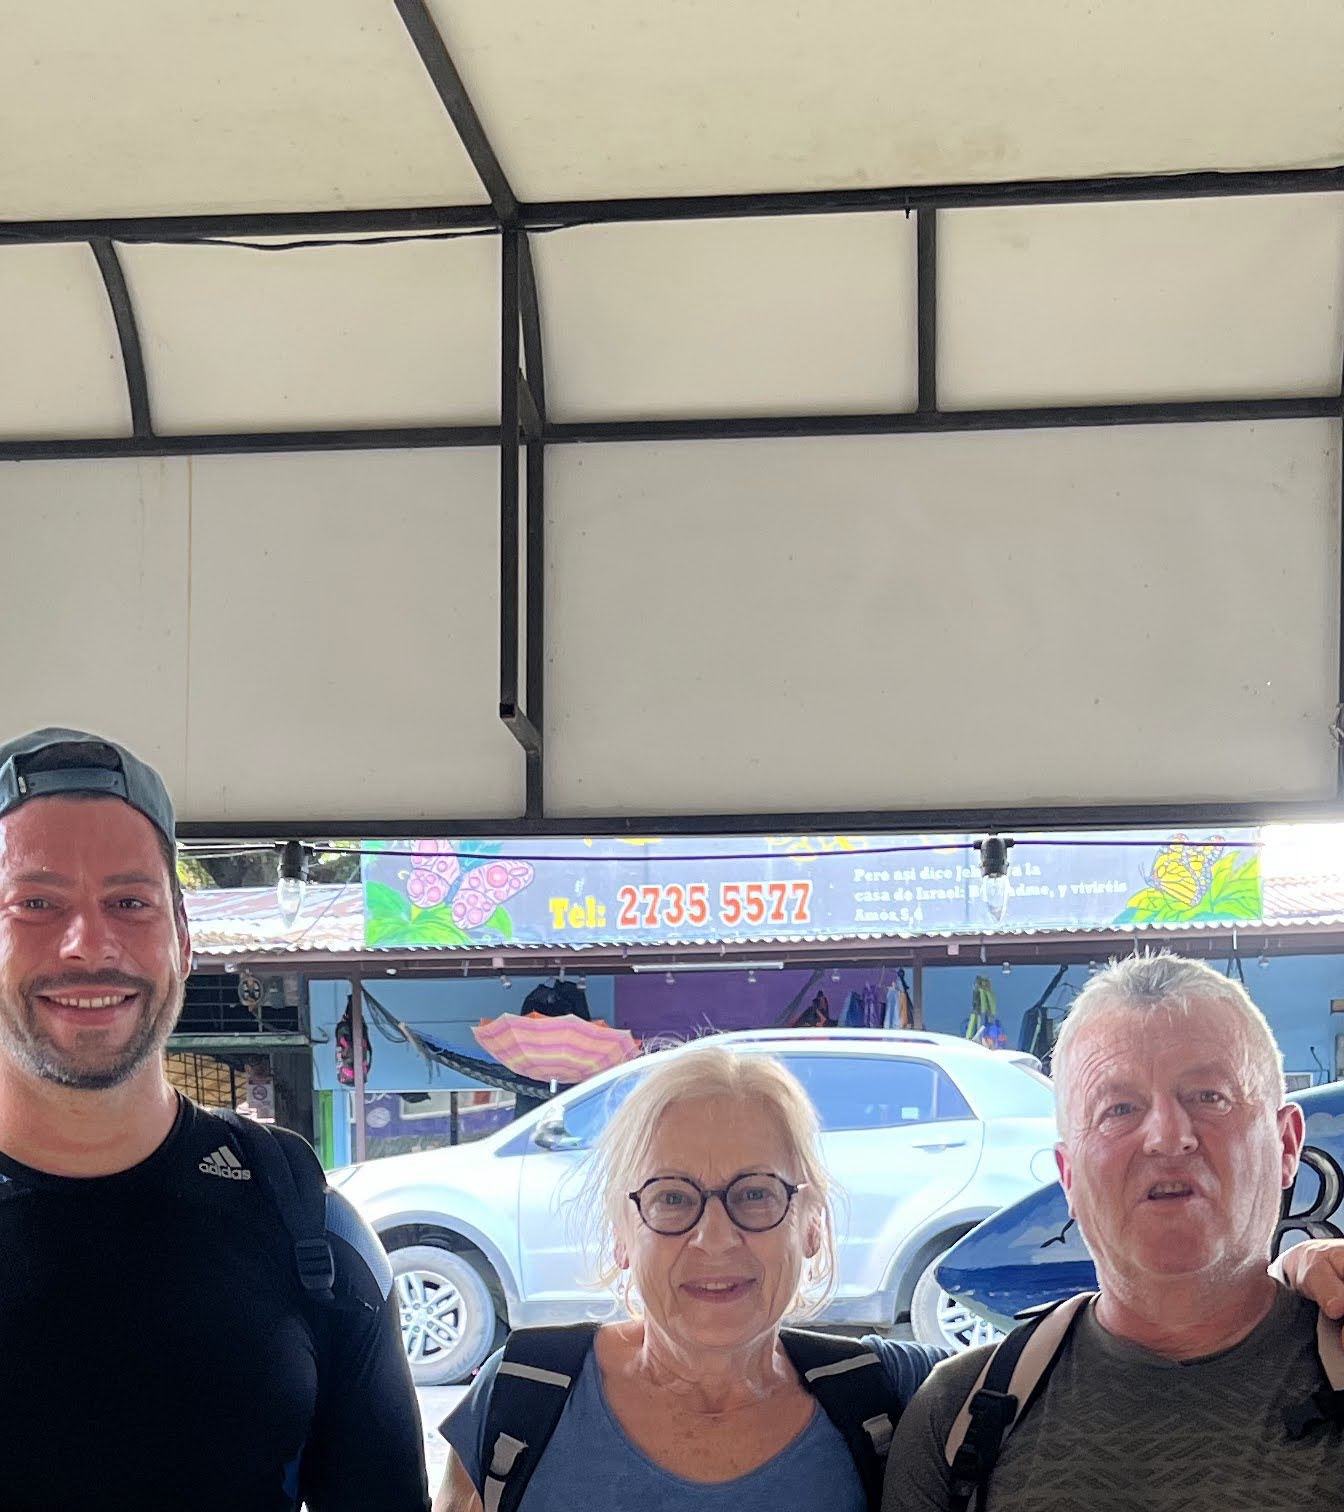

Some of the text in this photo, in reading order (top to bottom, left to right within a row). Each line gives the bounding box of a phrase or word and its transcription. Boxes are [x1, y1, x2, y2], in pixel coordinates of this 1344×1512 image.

[919, 866, 953, 881] dice
[853, 891, 890, 902] casa
[893, 888, 913, 902] de
[549, 880, 813, 929] Tel: 2735 5577
[198, 1162, 252, 1182] adidas
